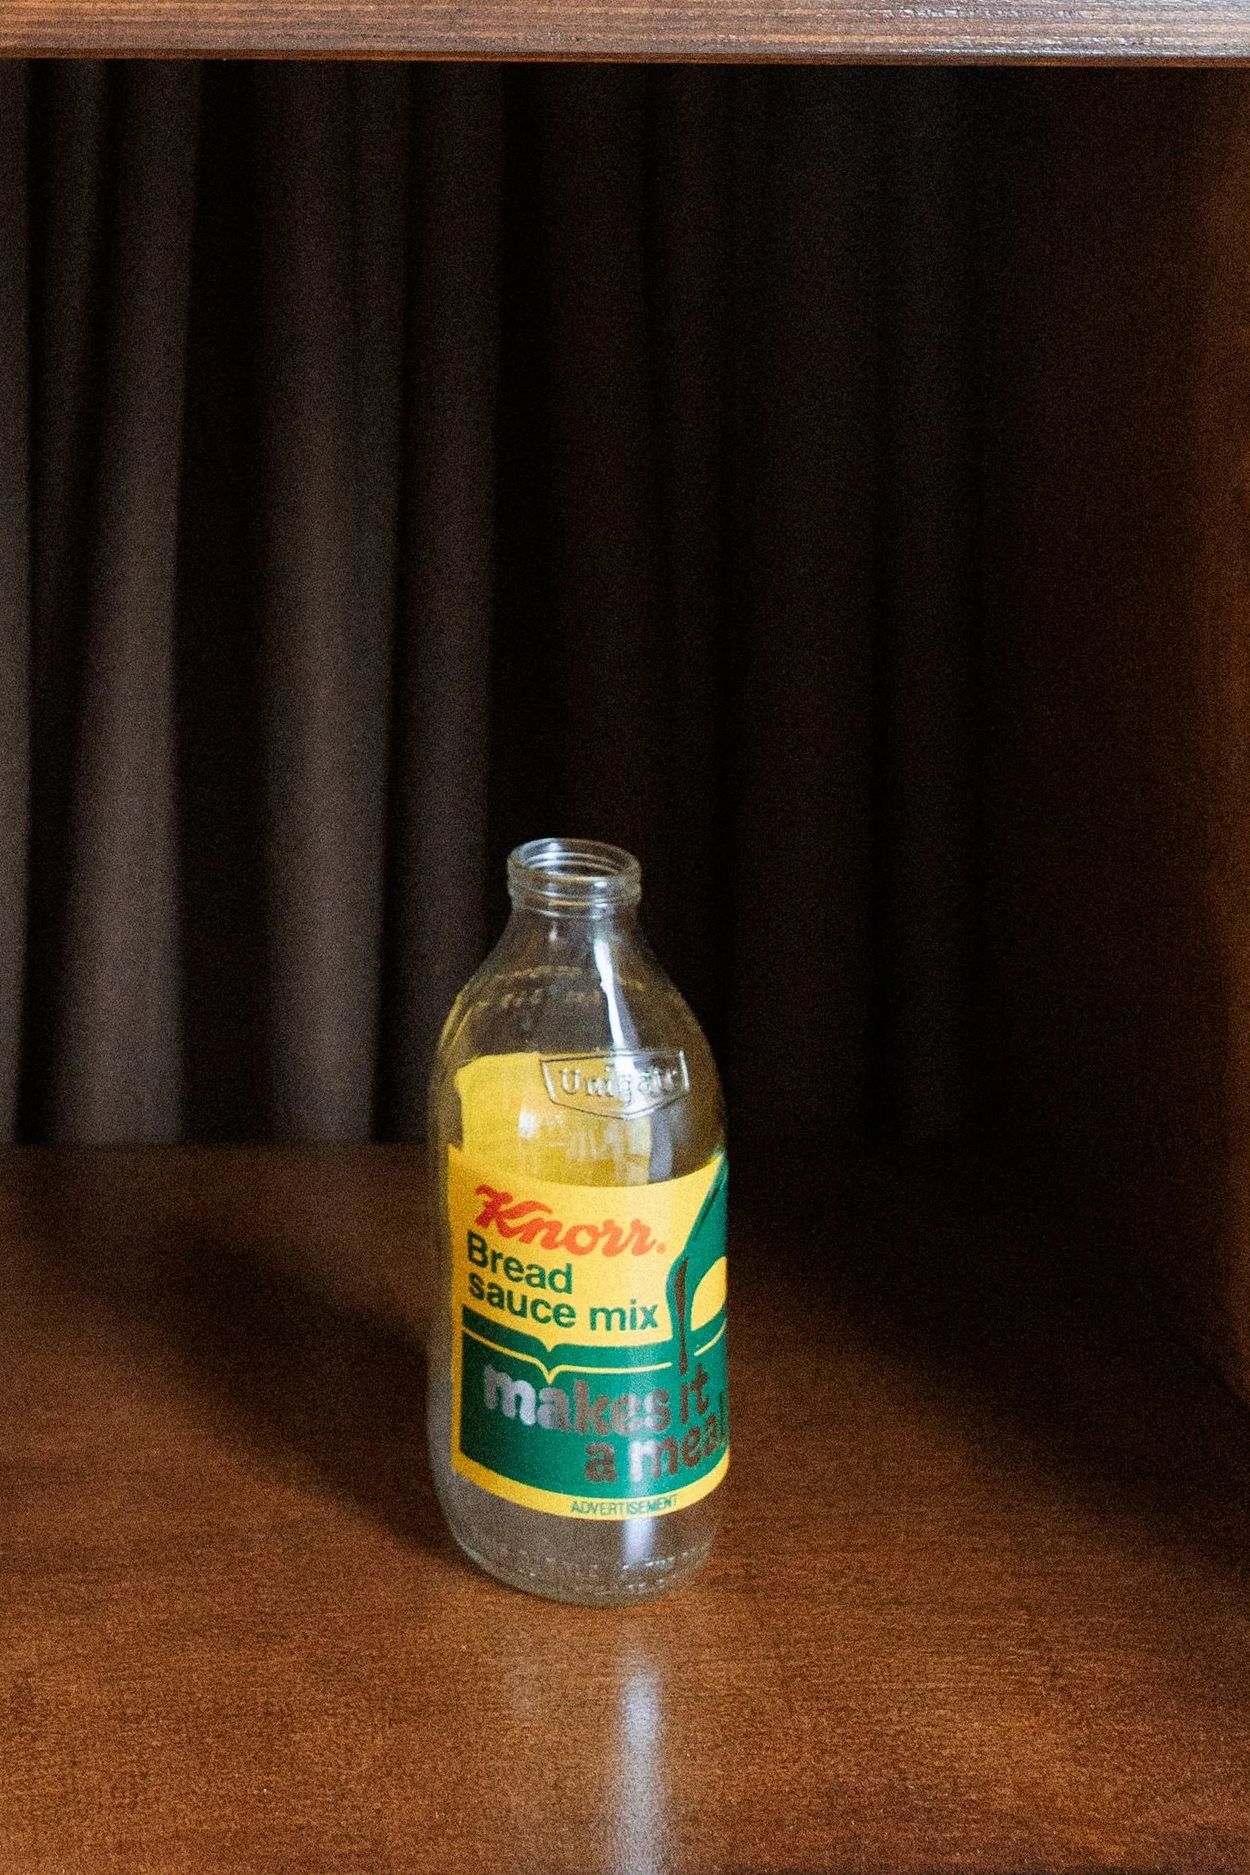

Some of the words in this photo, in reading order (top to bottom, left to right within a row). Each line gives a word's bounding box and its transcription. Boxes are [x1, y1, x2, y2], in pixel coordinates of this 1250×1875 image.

[467, 1229, 573, 1295] Bread
[468, 1272, 577, 1329] sauce
[588, 1298, 659, 1332] mix
[484, 1364, 672, 1436] makes
[679, 1362, 710, 1425] it
[584, 1442, 618, 1484] a
[570, 1494, 678, 1515] ADVERTISEMENT
